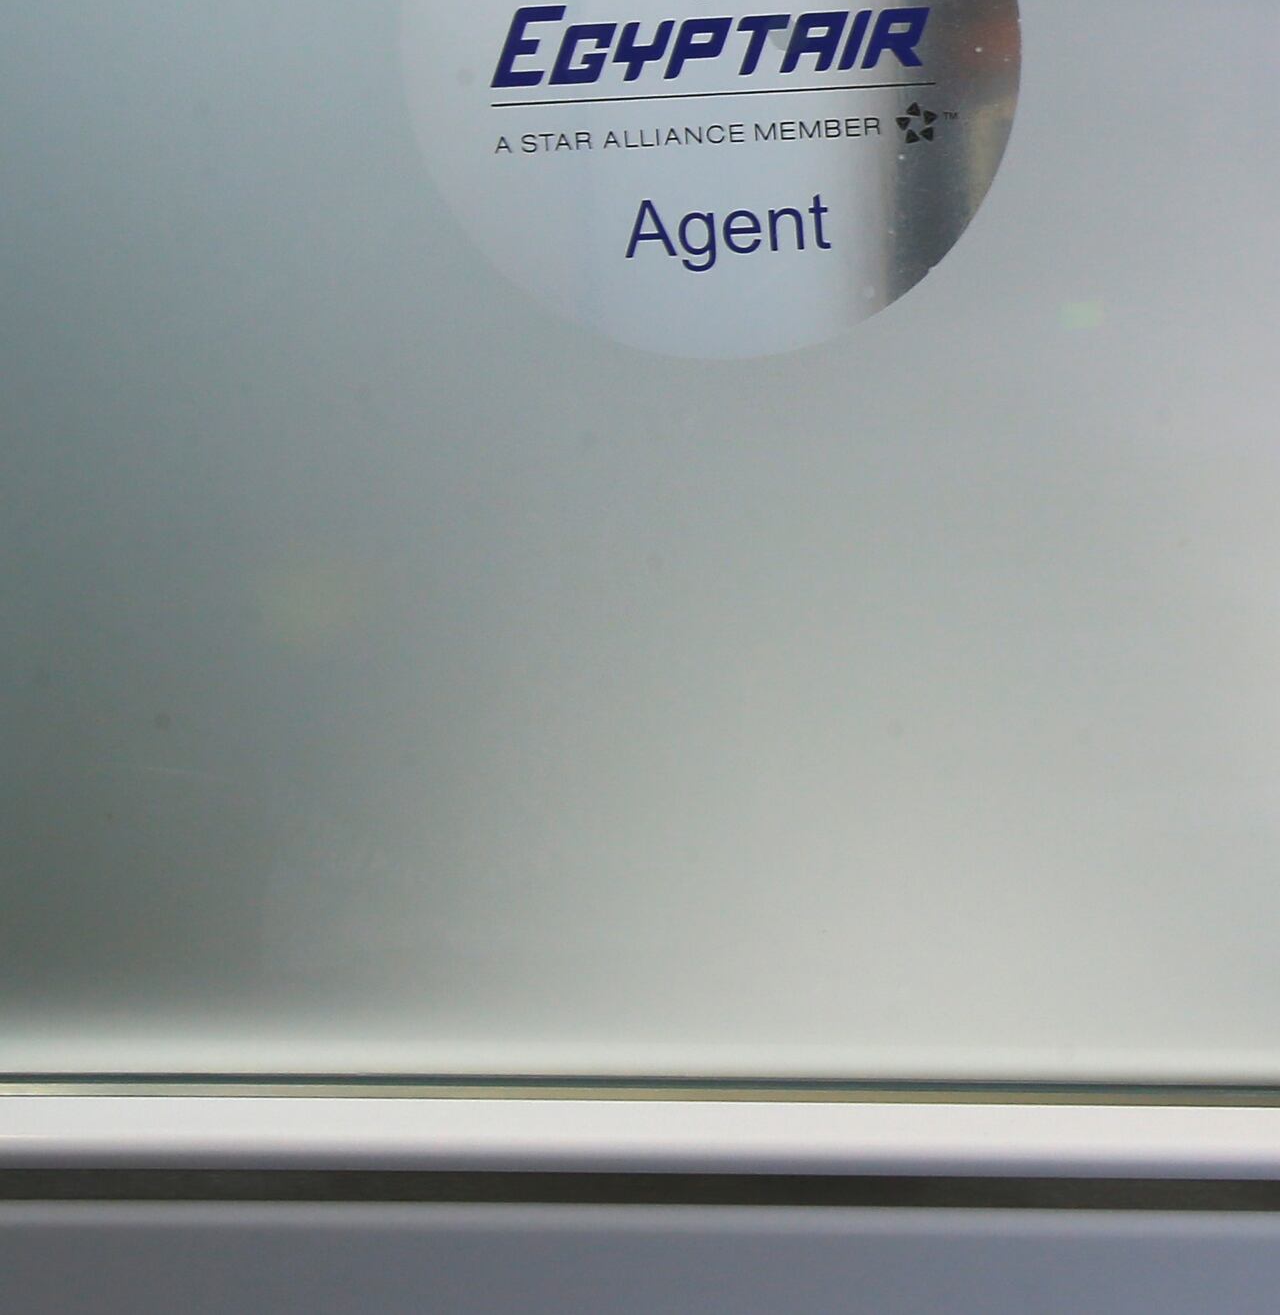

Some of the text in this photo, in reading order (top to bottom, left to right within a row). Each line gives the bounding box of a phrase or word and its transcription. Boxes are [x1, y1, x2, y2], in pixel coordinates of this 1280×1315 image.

[490, 4, 931, 88] EGYPTAIR
[494, 135, 512, 154] A
[520, 131, 593, 154] STAR
[602, 123, 745, 149] ALLIANCE
[754, 117, 881, 141] MEMBER
[624, 194, 832, 273] Agent
